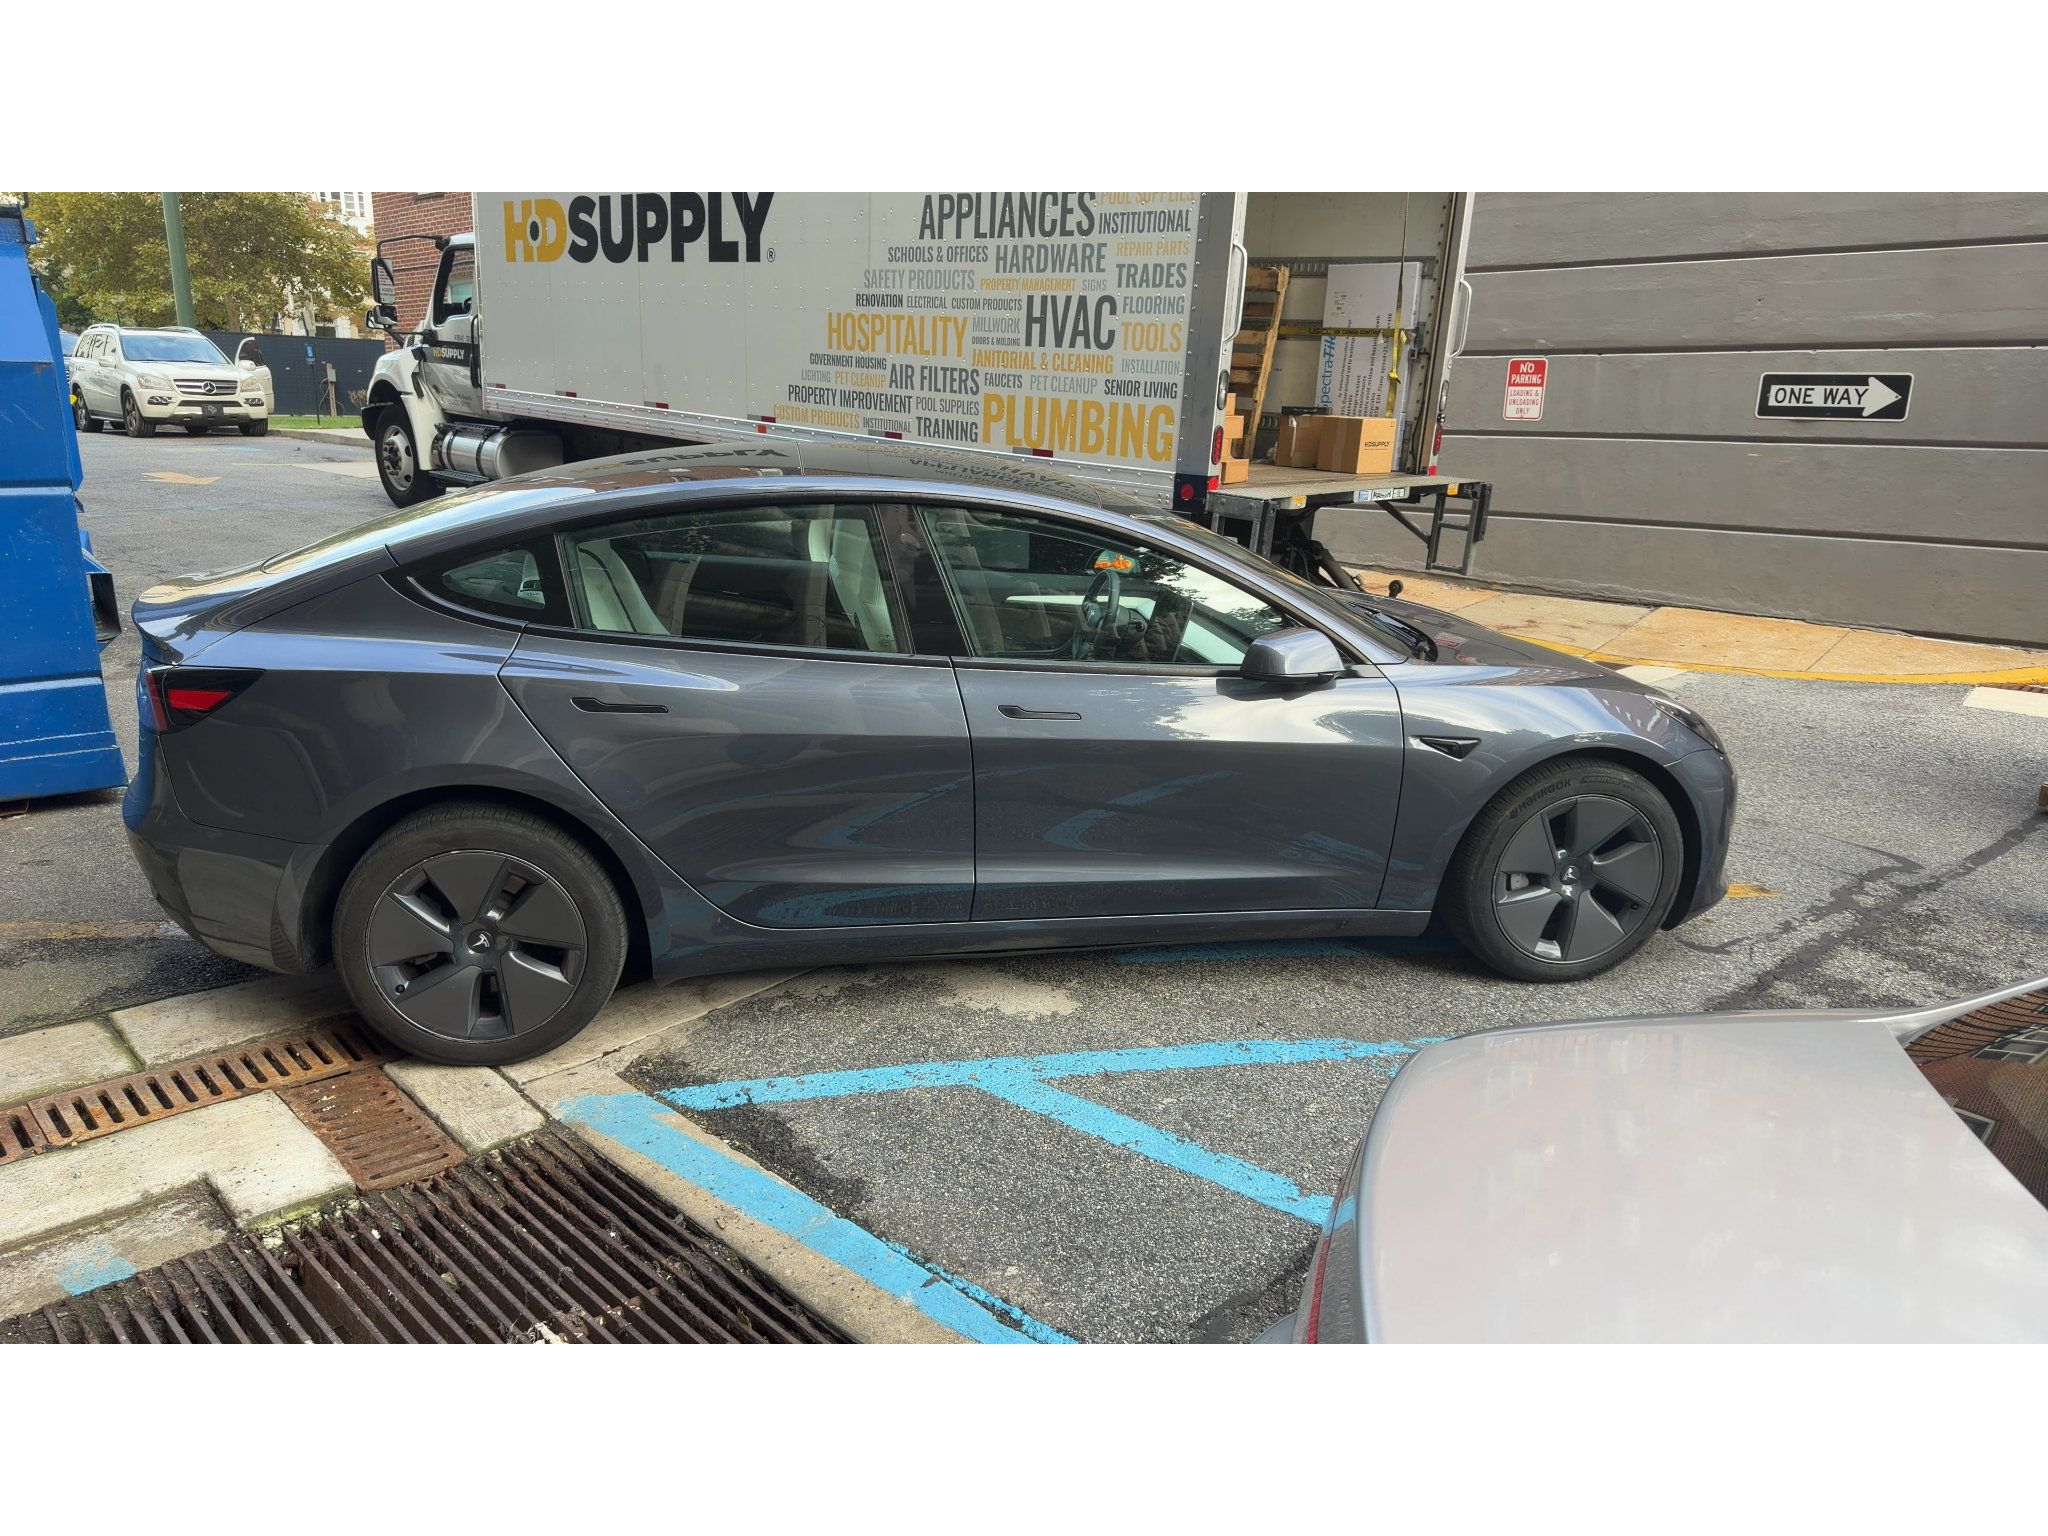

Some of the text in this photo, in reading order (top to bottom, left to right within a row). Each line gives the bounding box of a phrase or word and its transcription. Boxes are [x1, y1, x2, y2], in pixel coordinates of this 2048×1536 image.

[919, 192, 1096, 240] APPLIANCES
[1098, 209, 1191, 234] INSTITUTIONAL
[888, 246, 988, 263] SCHOOLS & OFFICES
[1116, 240, 1190, 256] REPAIR PARTS
[995, 243, 1107, 273] HARDWARE
[864, 269, 976, 290] SAFETY PRODUCTS
[980, 278, 1076, 291] PROPERTY MANAGEMENT
[1116, 262, 1188, 289] TRADES
[1082, 279, 1107, 292] SIGNS
[856, 294, 904, 308] RENOVATION
[906, 296, 948, 309] ELECTRICAL
[951, 298, 1022, 311] CUSTOM PRODUCTS
[1122, 296, 1185, 315] FLOORING
[972, 316, 1020, 334] MILLWORK
[1024, 294, 1118, 350] HVAC
[827, 311, 968, 358] HOSPITALITY
[972, 336, 990, 345] DOORS
[996, 337, 1020, 346] MOLDING
[1121, 321, 1184, 353] TOOLS
[810, 352, 887, 370] GOVERNMENT HOUSING
[972, 348, 1114, 374] JANITORIAL & CLEANING
[1121, 358, 1180, 376] INSTALLATION
[1520, 362, 1534, 373] NO
[801, 368, 831, 382] LIGHTING
[835, 370, 886, 388] PET CLEANUP
[888, 363, 980, 396] AIR FILTERS
[984, 372, 1023, 388] FAUCETS
[1319, 335, 1336, 408] pectraTile
[1511, 374, 1542, 384] PARKING
[1030, 374, 1098, 394] PET CLEANUP
[1104, 378, 1178, 400] SENIOR LIVING
[788, 384, 912, 414] PROPERTY IMPROVEMENT
[916, 396, 980, 416] POOL SUPPLIES
[1774, 388, 1869, 405] ONE WAY
[774, 404, 860, 430] CUSTOM PRODUCTS
[863, 416, 912, 434] INSTITUTIONAL
[916, 416, 978, 443] TRAINING
[982, 392, 1175, 462] PLUMBING
